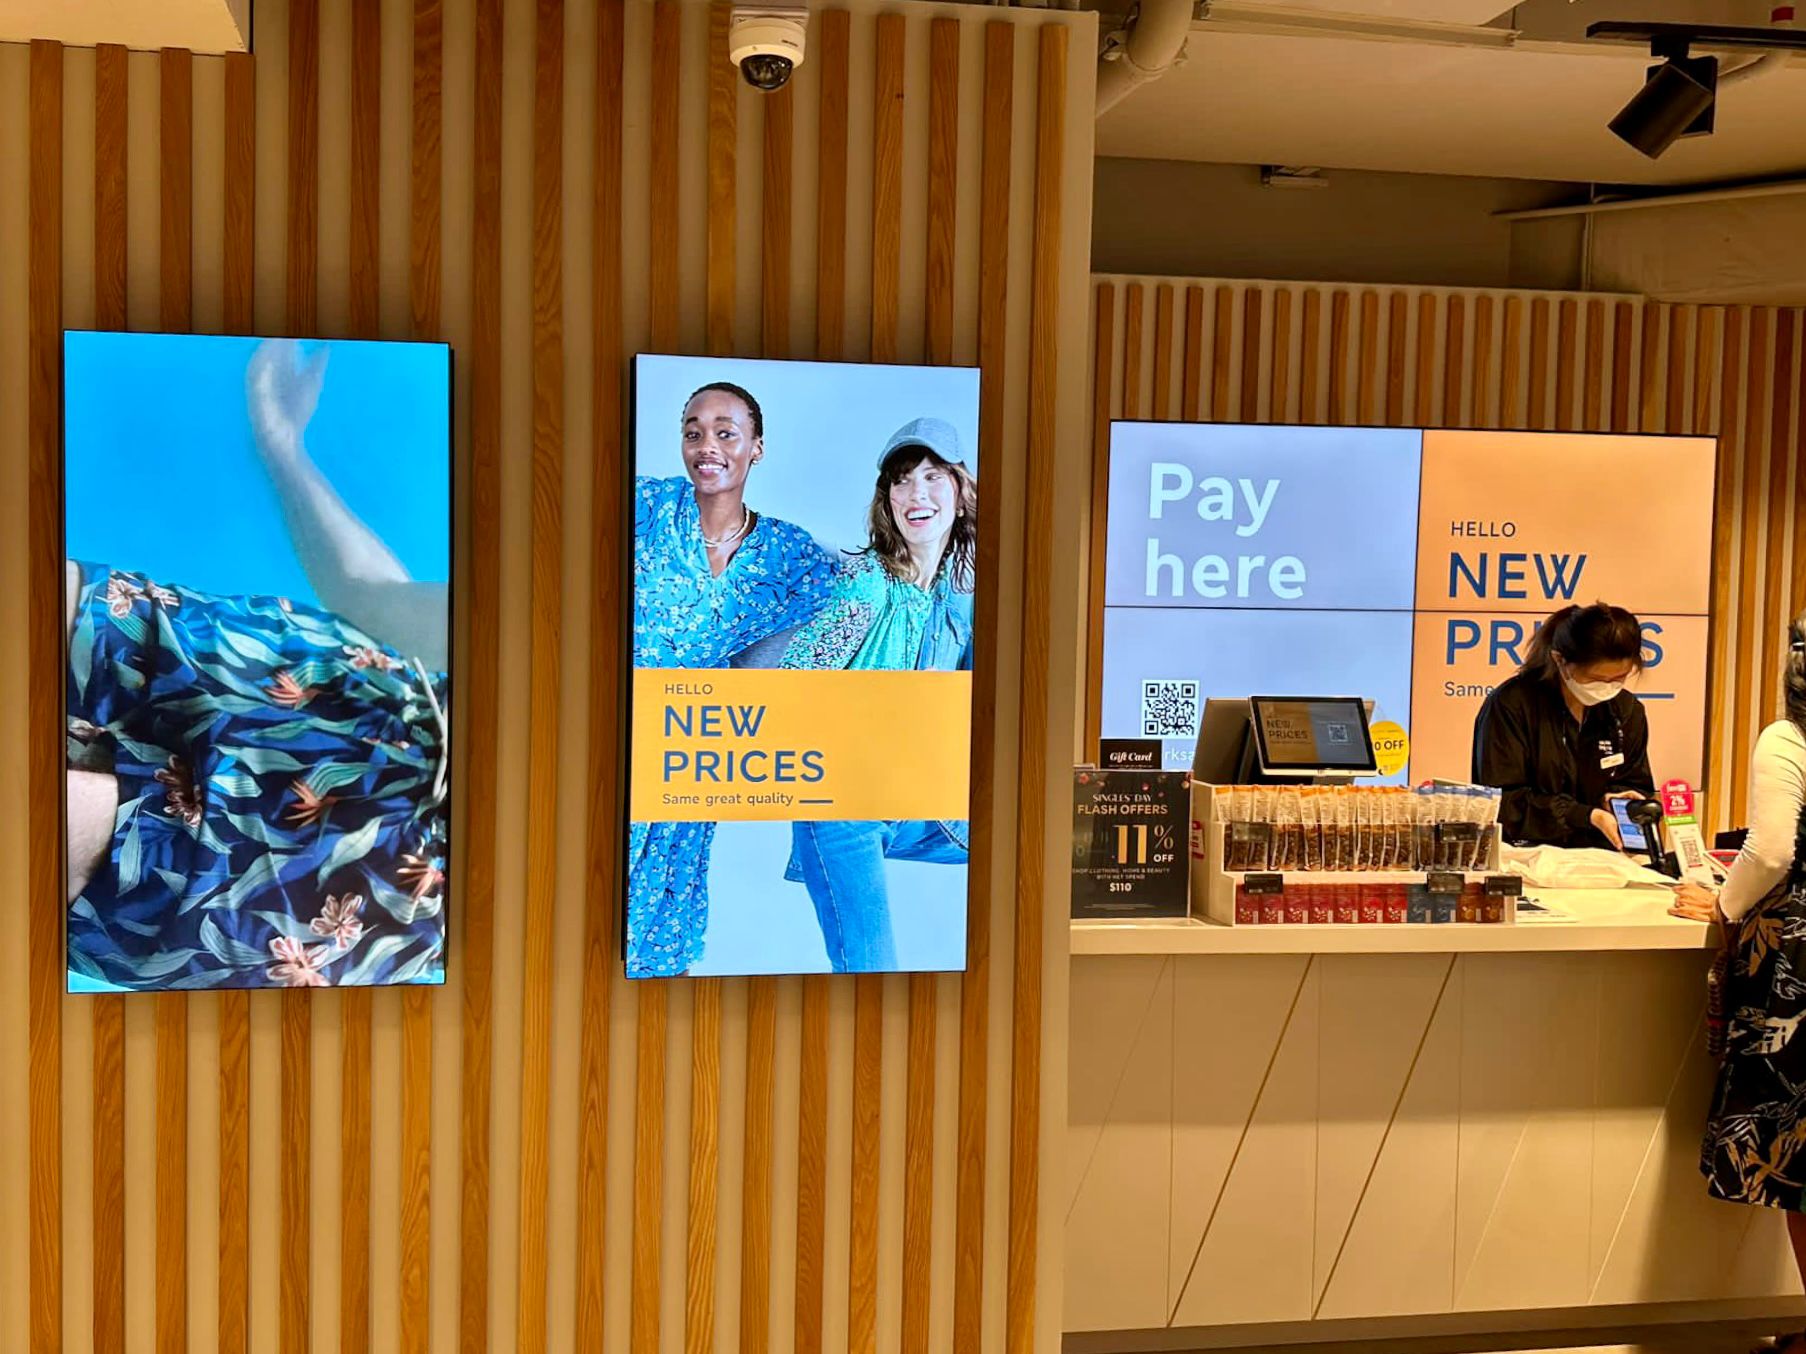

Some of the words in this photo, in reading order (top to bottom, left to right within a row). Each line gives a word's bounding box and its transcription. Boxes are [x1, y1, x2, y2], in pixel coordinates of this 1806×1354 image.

[1149, 462, 1281, 537] Pay
[1450, 520, 1516, 537] HELLO
[1145, 537, 1307, 599] here
[1448, 552, 1587, 600] NEW
[1446, 619, 1664, 668] PRS
[664, 683, 713, 695] HELLO
[1444, 681, 1494, 697] Same
[664, 705, 767, 737] NEW
[1268, 730, 1309, 739] PRICES
[1374, 741, 1381, 751] 0
[1384, 740, 1405, 750] OFF
[1109, 752, 1127, 763] Gift
[1128, 752, 1153, 762] Card
[663, 750, 825, 782] PRICES
[662, 793, 700, 805] Same
[705, 793, 742, 807] great
[747, 792, 794, 807] quality
[1077, 804, 1118, 815] FLASH
[1120, 804, 1169, 815] OFFERS
[1153, 854, 1175, 863] OFF
